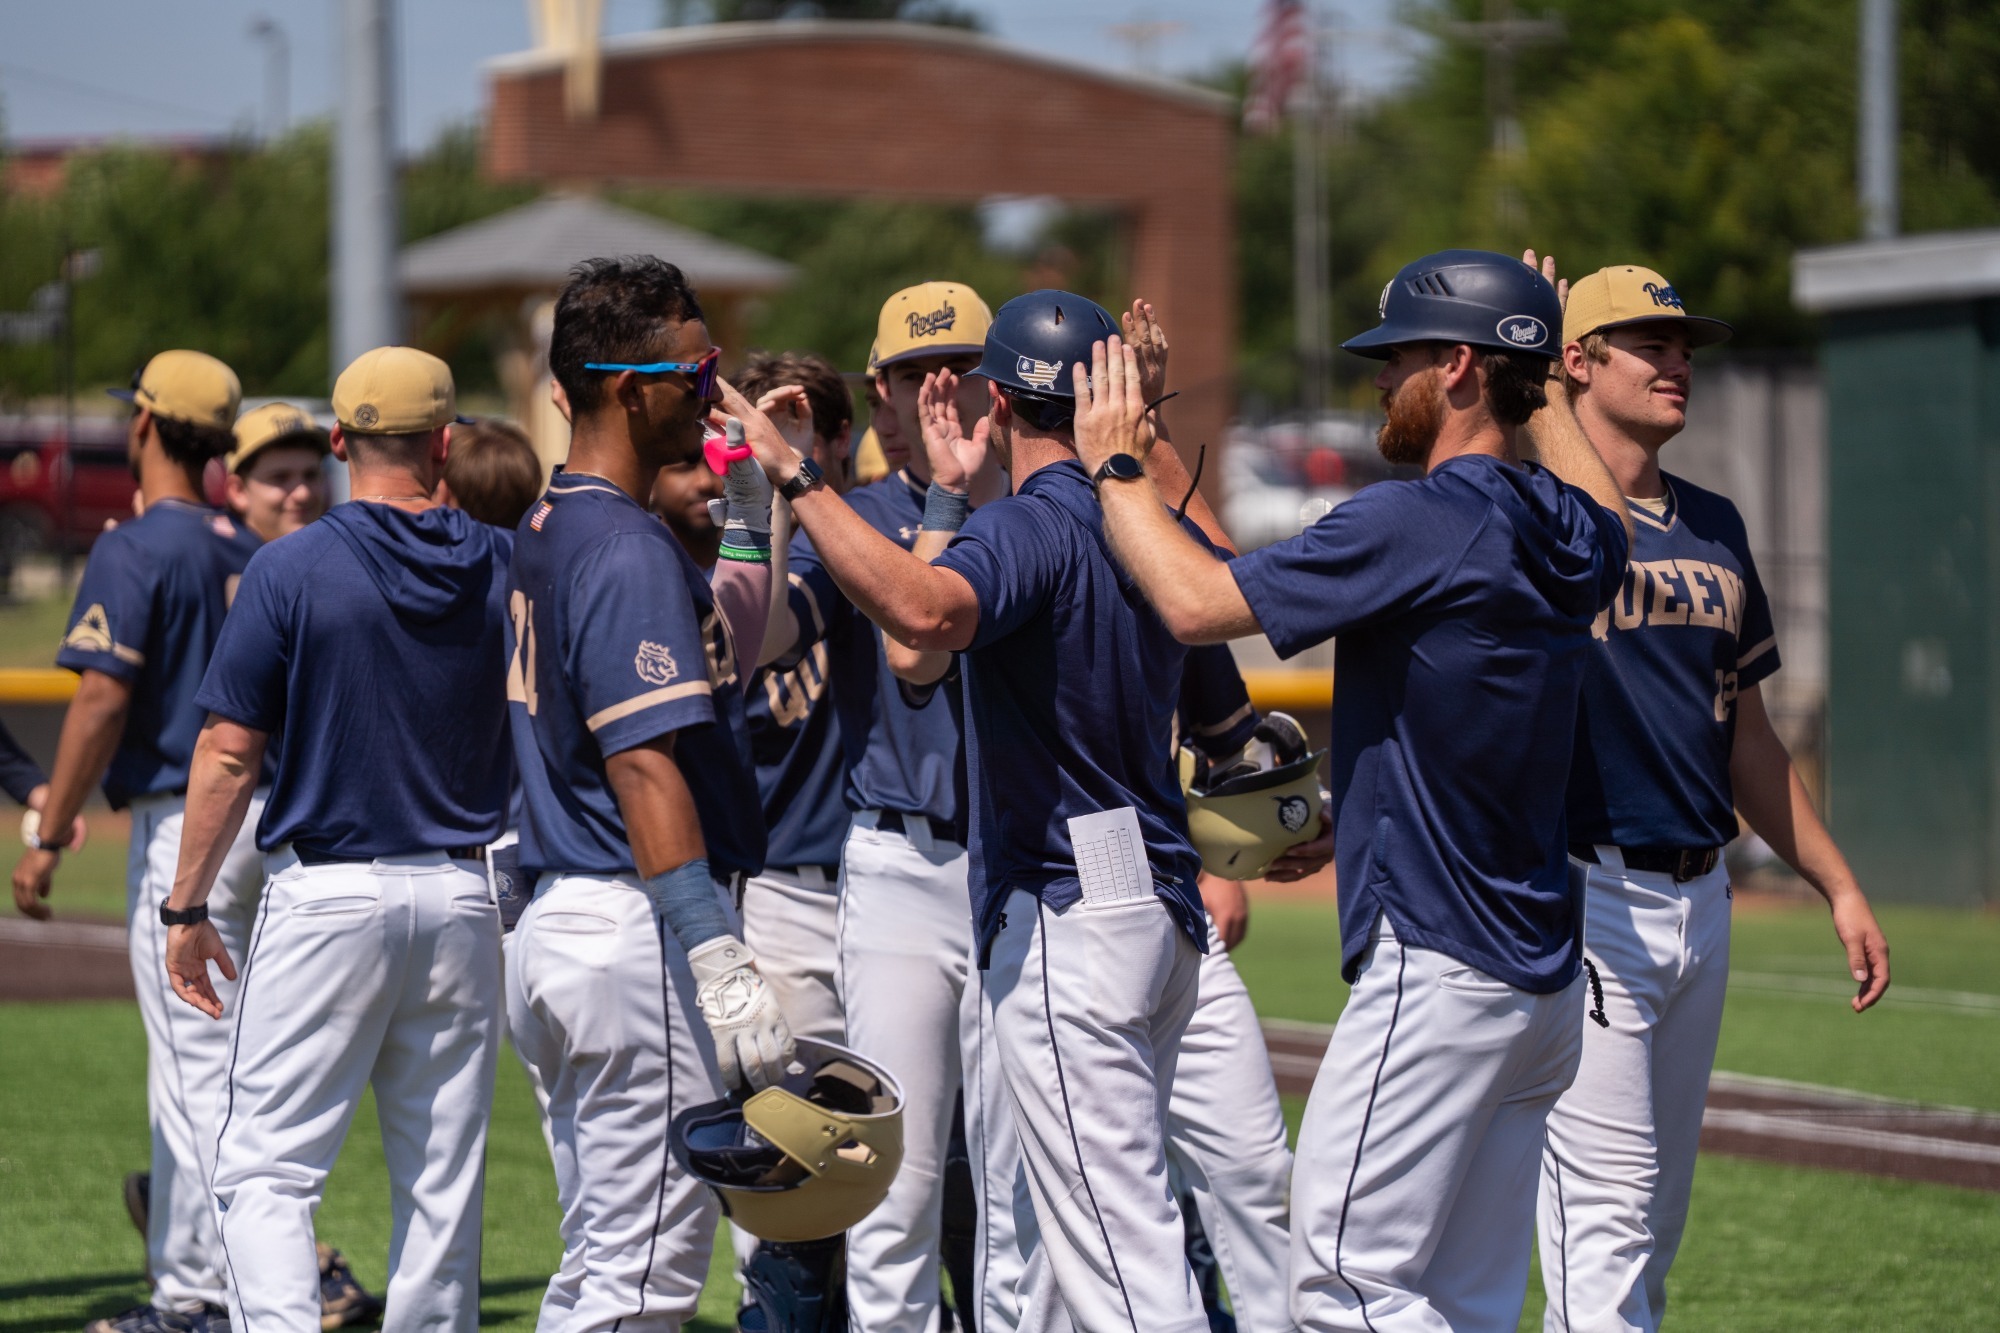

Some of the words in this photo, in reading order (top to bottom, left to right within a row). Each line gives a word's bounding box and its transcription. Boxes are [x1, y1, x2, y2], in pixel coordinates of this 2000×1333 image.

[904, 299, 956, 338] Royals
[1510, 320, 1538, 343] Royals
[507, 589, 538, 716] 21
